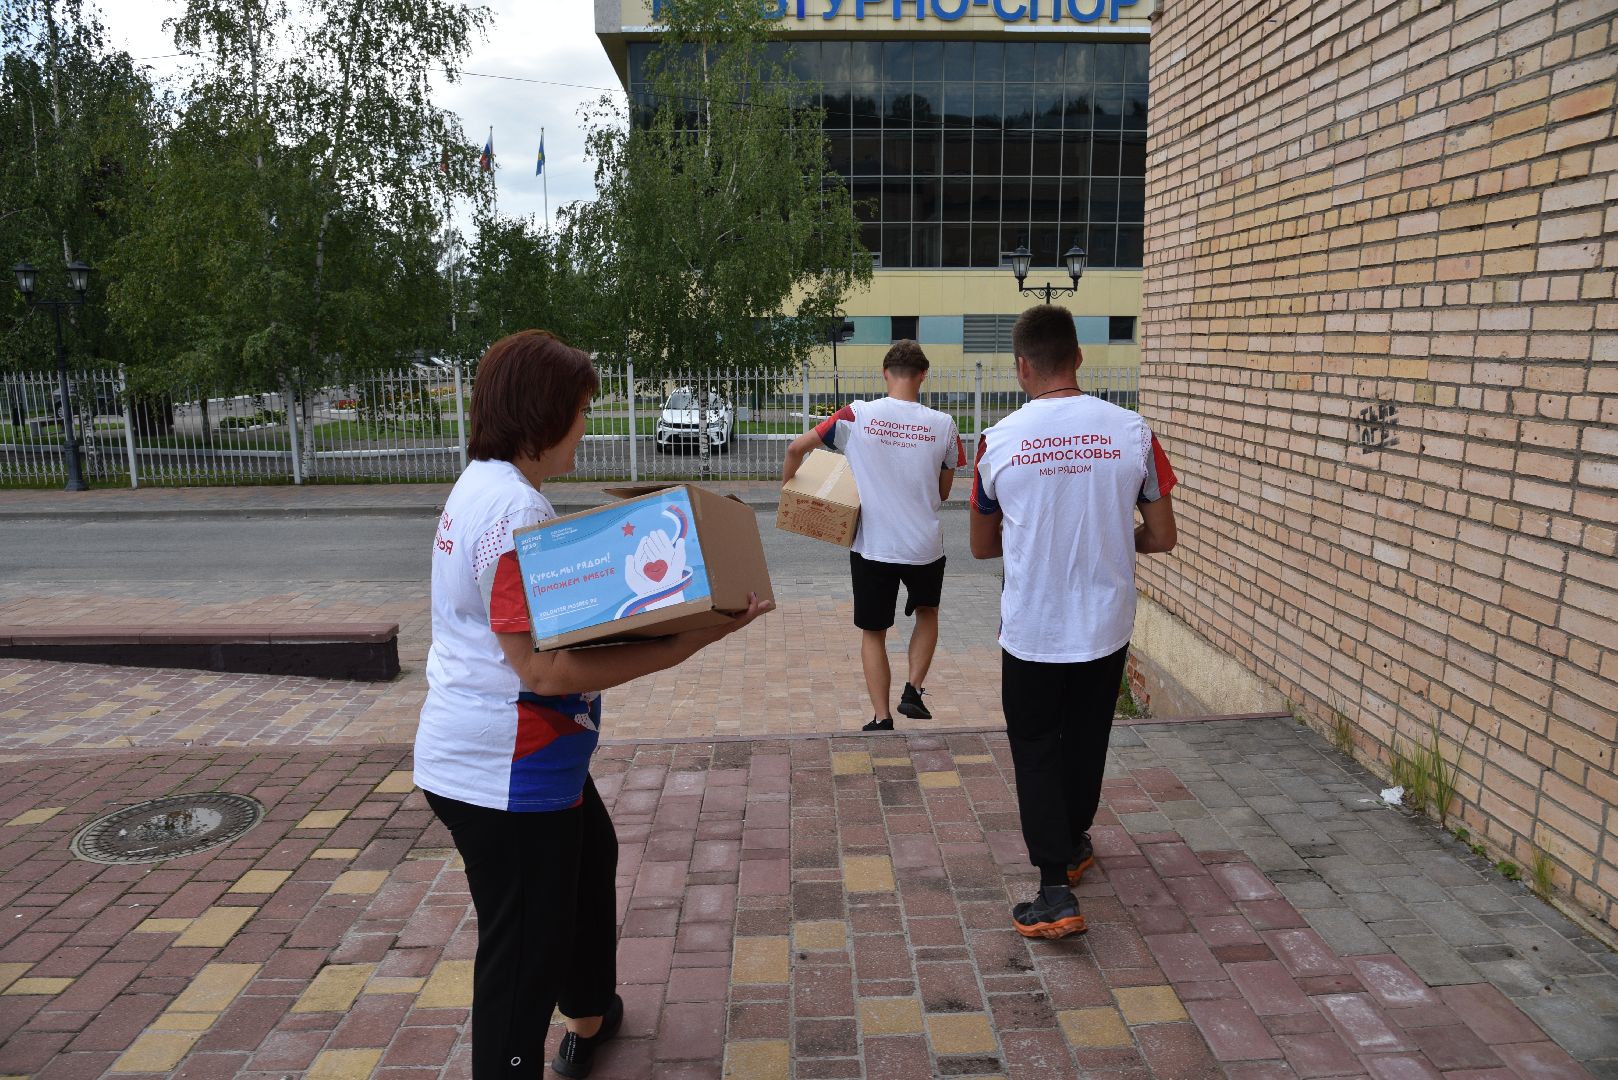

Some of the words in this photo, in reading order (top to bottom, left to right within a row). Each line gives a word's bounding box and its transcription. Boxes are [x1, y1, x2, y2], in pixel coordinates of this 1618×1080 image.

[870, 418, 932, 433] ВОЛОНТЕРЫ
[863, 426, 936, 442] ПОДМОСКОВЬЯ
[892, 440, 917, 449] РЯДОМ
[1021, 434, 1111, 451] ВОЛОНТЕРЫ
[1011, 448, 1121, 466] ПОДМОСКОВЬЯ
[1039, 467, 1056, 477] МЫ
[1058, 464, 1092, 475] РЯДОМ
